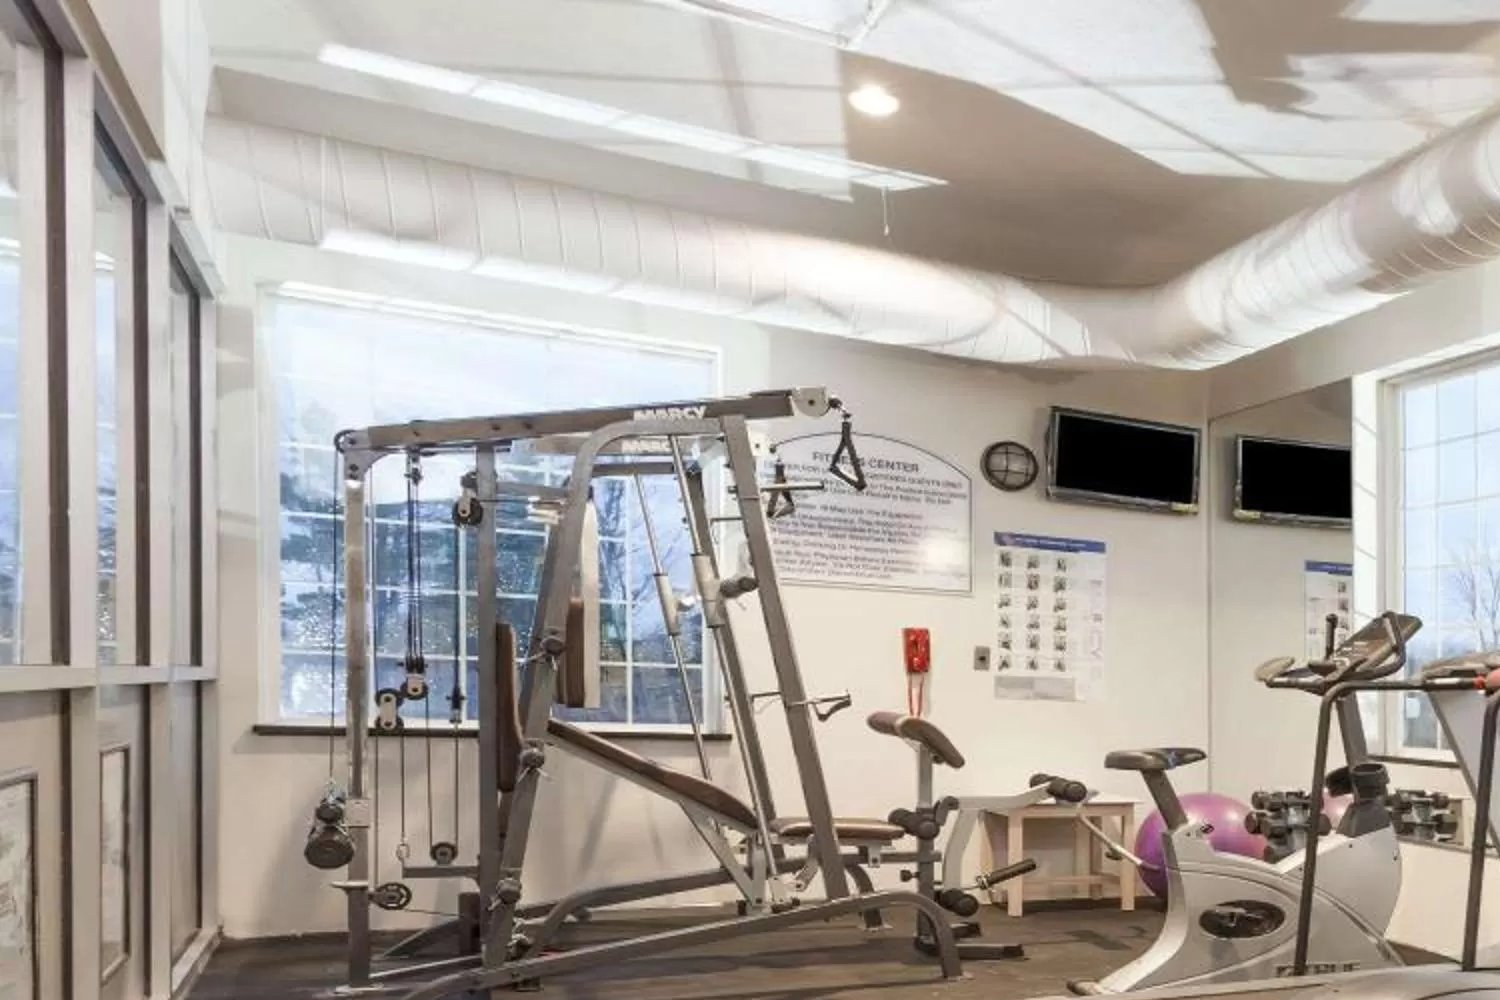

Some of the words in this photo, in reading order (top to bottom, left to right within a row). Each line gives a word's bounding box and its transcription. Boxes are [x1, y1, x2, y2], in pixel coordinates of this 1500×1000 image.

[633, 405, 707, 420] MARCY
[621, 440, 673, 454] MARC
[868, 458, 919, 473] CENTER
